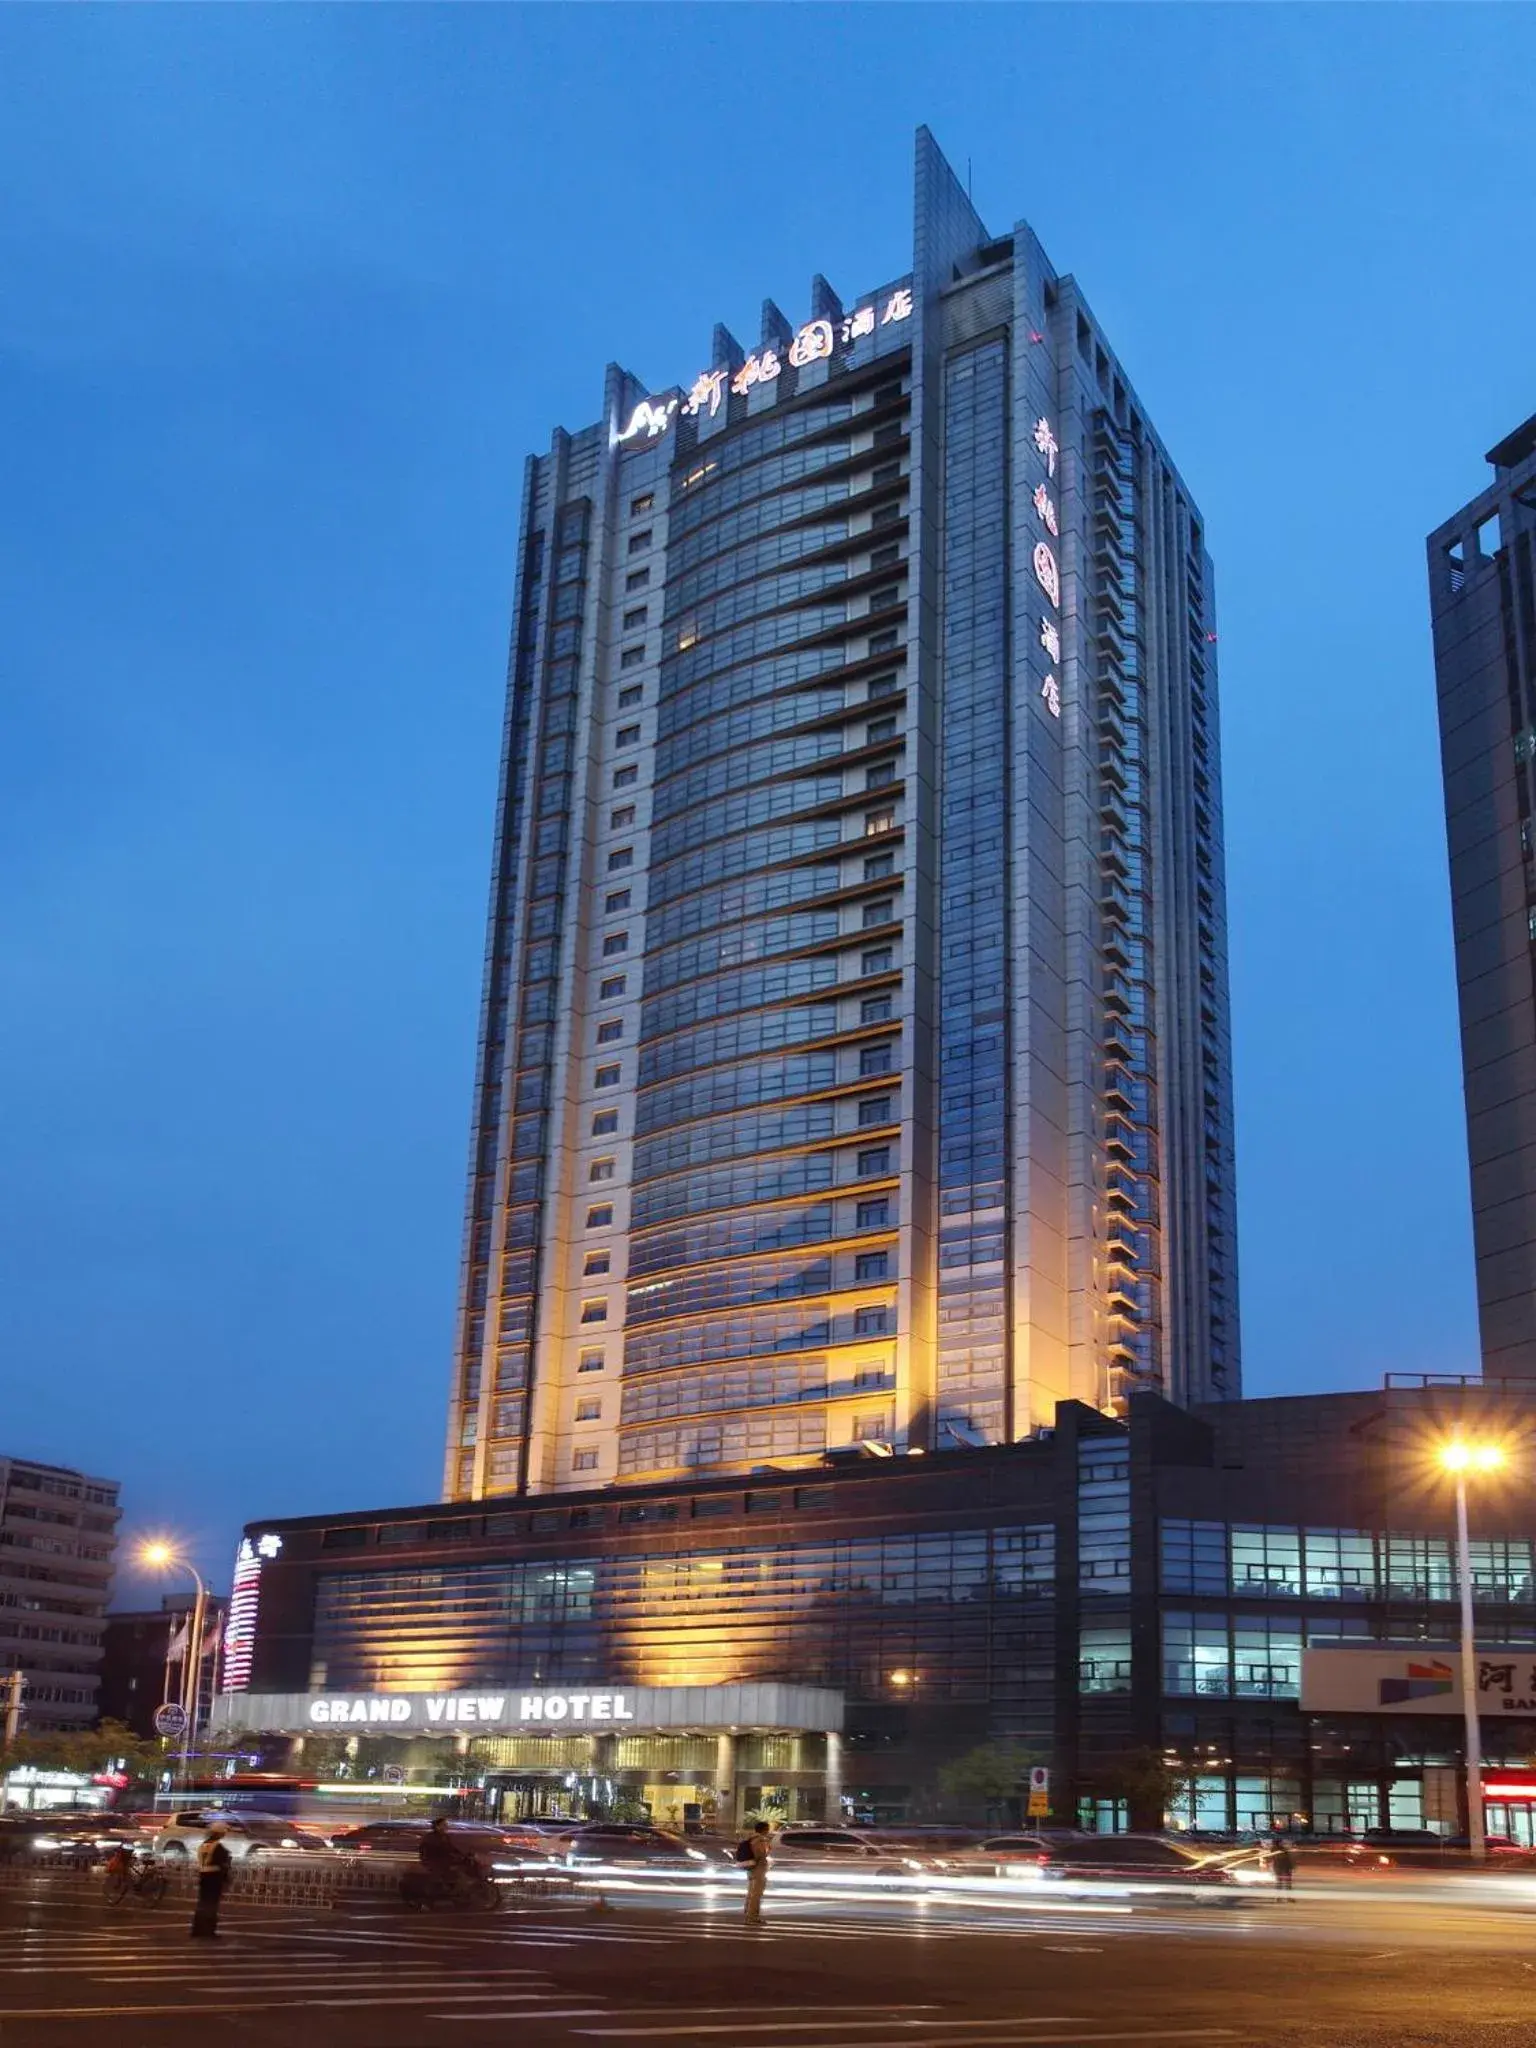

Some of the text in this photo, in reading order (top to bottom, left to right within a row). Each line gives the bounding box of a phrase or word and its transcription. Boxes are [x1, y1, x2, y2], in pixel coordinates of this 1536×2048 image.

[1478, 1661, 1536, 1693] 河
[310, 1695, 634, 1723] GRAND VIEW HOTEL
